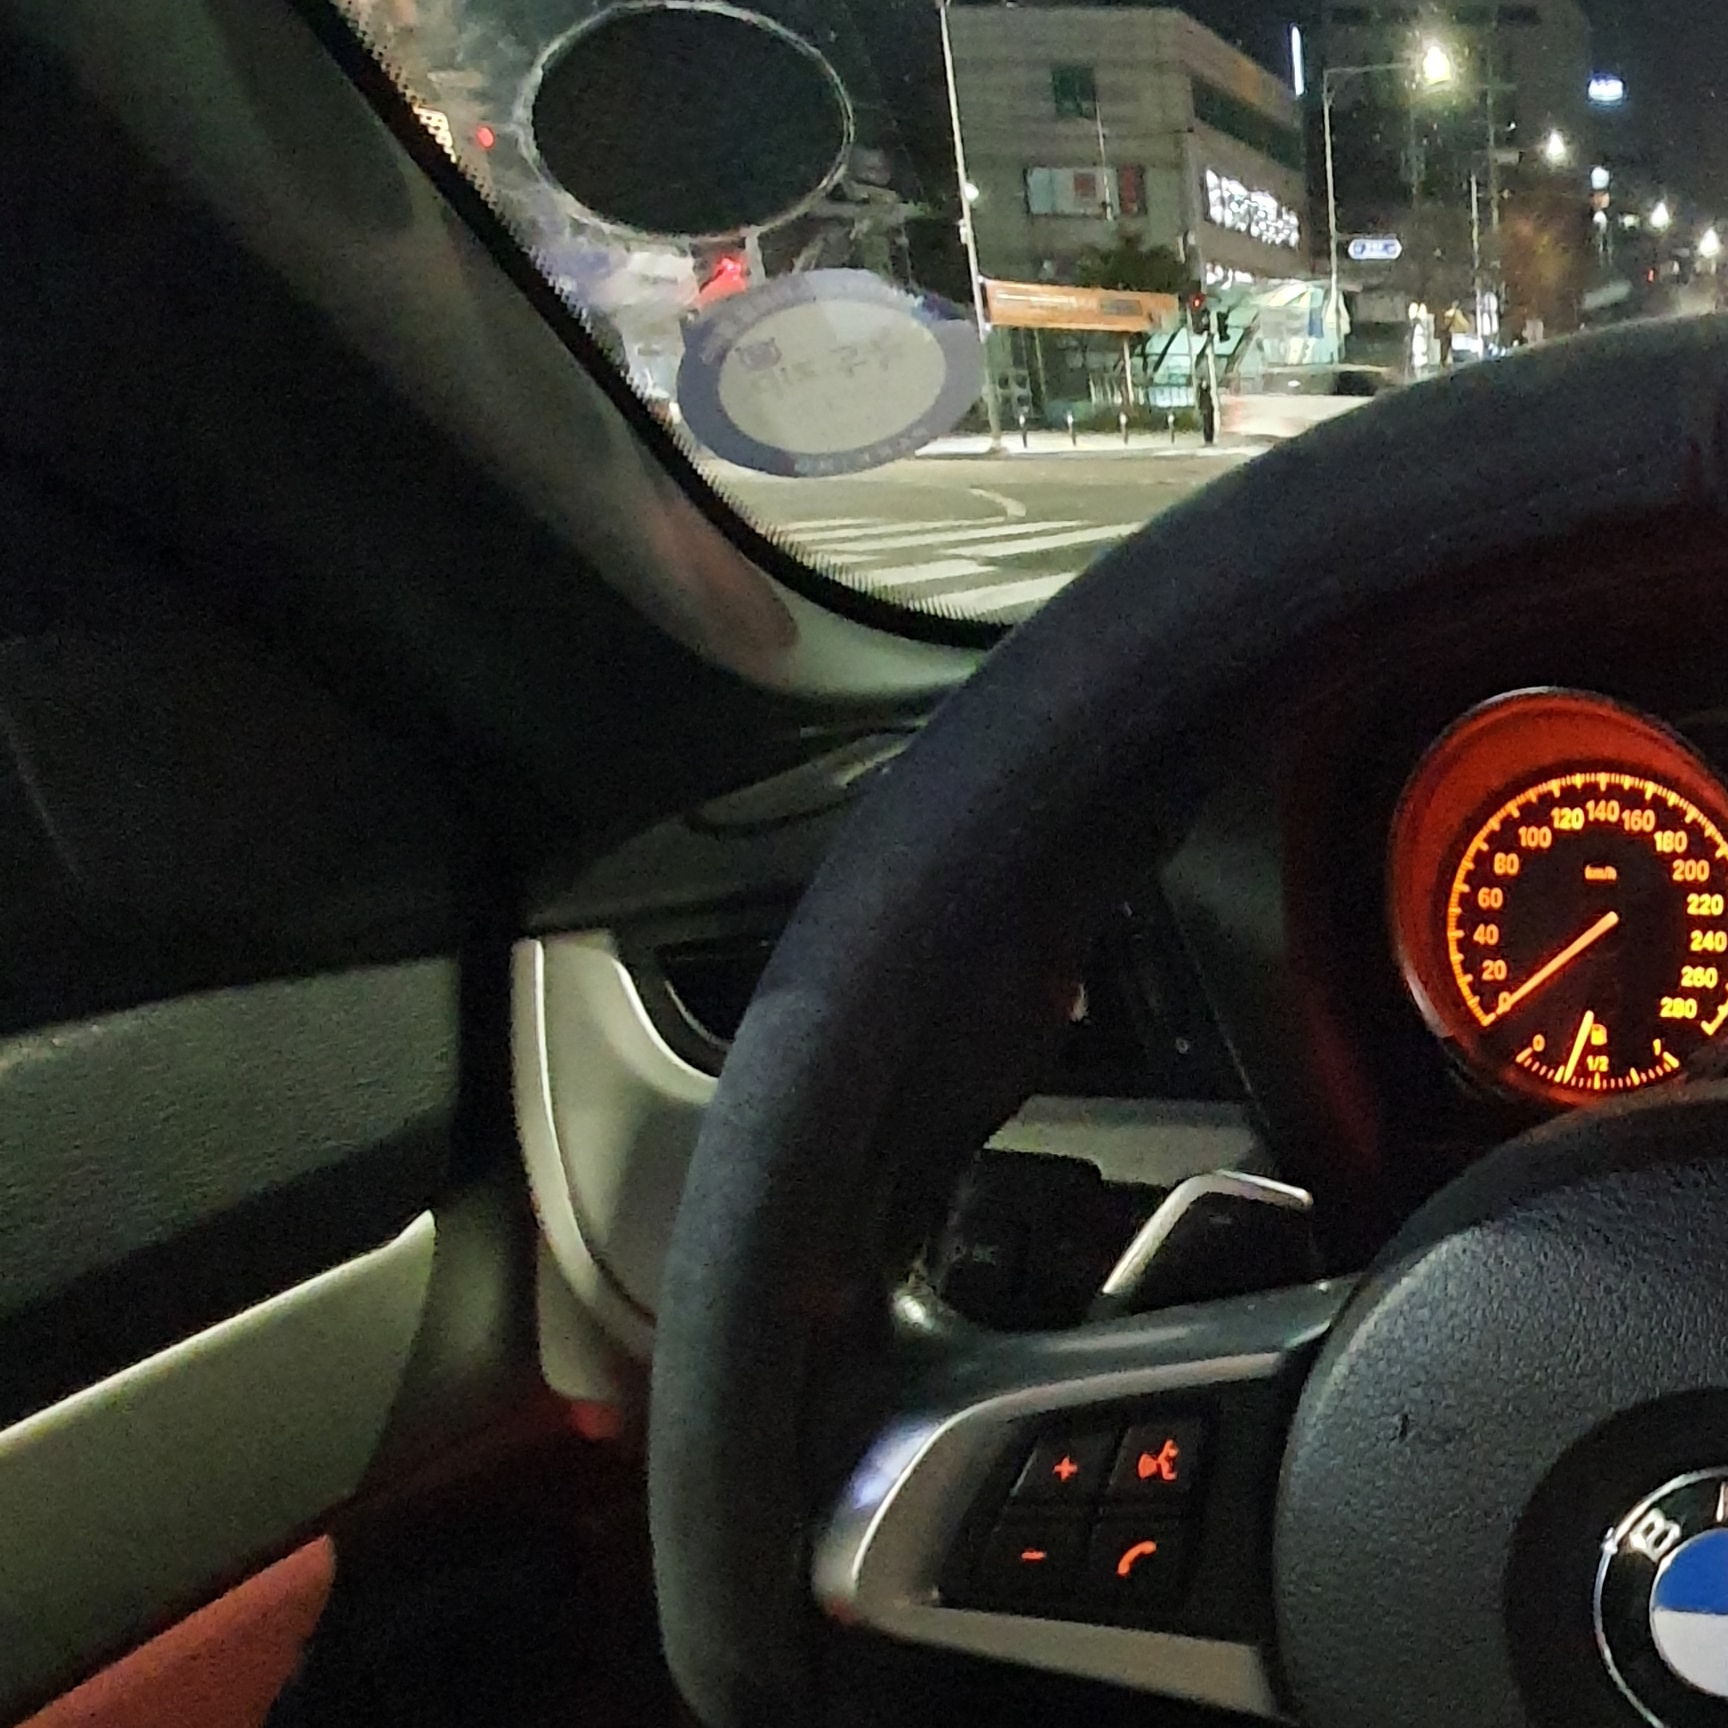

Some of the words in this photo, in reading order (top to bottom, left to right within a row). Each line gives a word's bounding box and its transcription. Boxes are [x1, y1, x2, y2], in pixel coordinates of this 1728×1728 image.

[1551, 807, 1585, 830] 120
[1585, 799, 1620, 822] 140
[1621, 809, 1656, 832] 160
[1518, 826, 1552, 848] 100
[1653, 830, 1688, 853] 180
[1493, 852, 1520, 876] 80
[1672, 859, 1710, 882] 200
[1477, 887, 1503, 910] 60
[1687, 893, 1724, 916] 220
[1473, 923, 1499, 946] 40
[1690, 930, 1728, 952] 240
[1481, 959, 1507, 981] 20
[1681, 965, 1719, 989] 260
[1659, 996, 1698, 1019] 280
[1532, 1033, 1545, 1052] 0
[1652, 1038, 1661, 1056] 1
[1586, 1055, 1609, 1072] 1/2
